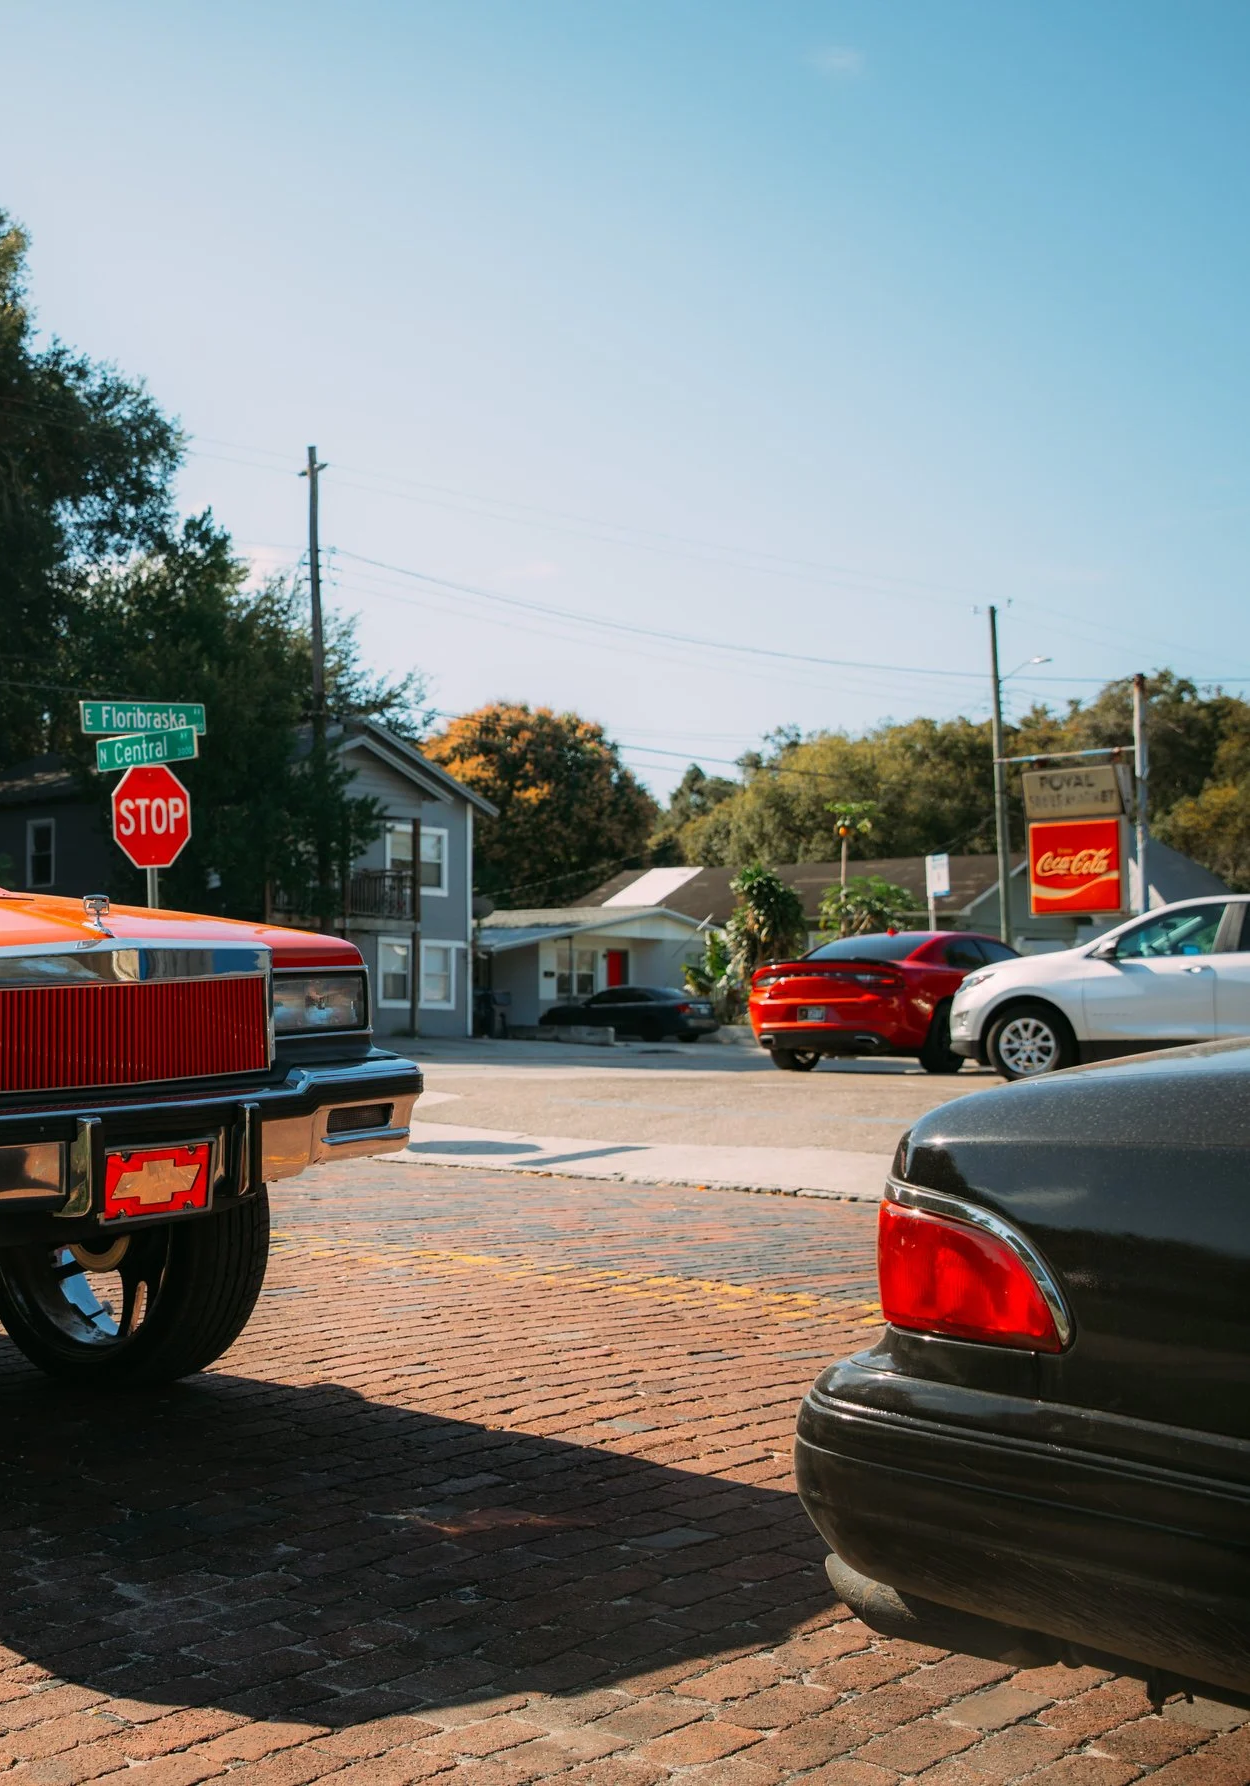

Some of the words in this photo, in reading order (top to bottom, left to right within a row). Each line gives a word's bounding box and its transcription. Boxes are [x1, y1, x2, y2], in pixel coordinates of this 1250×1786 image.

[85, 709, 93, 725] E
[102, 706, 186, 729] Floribraska
[100, 748, 107, 764] N
[114, 735, 168, 764] Central
[119, 797, 185, 836] STOP
[1036, 847, 1113, 877] Coca-Cola
